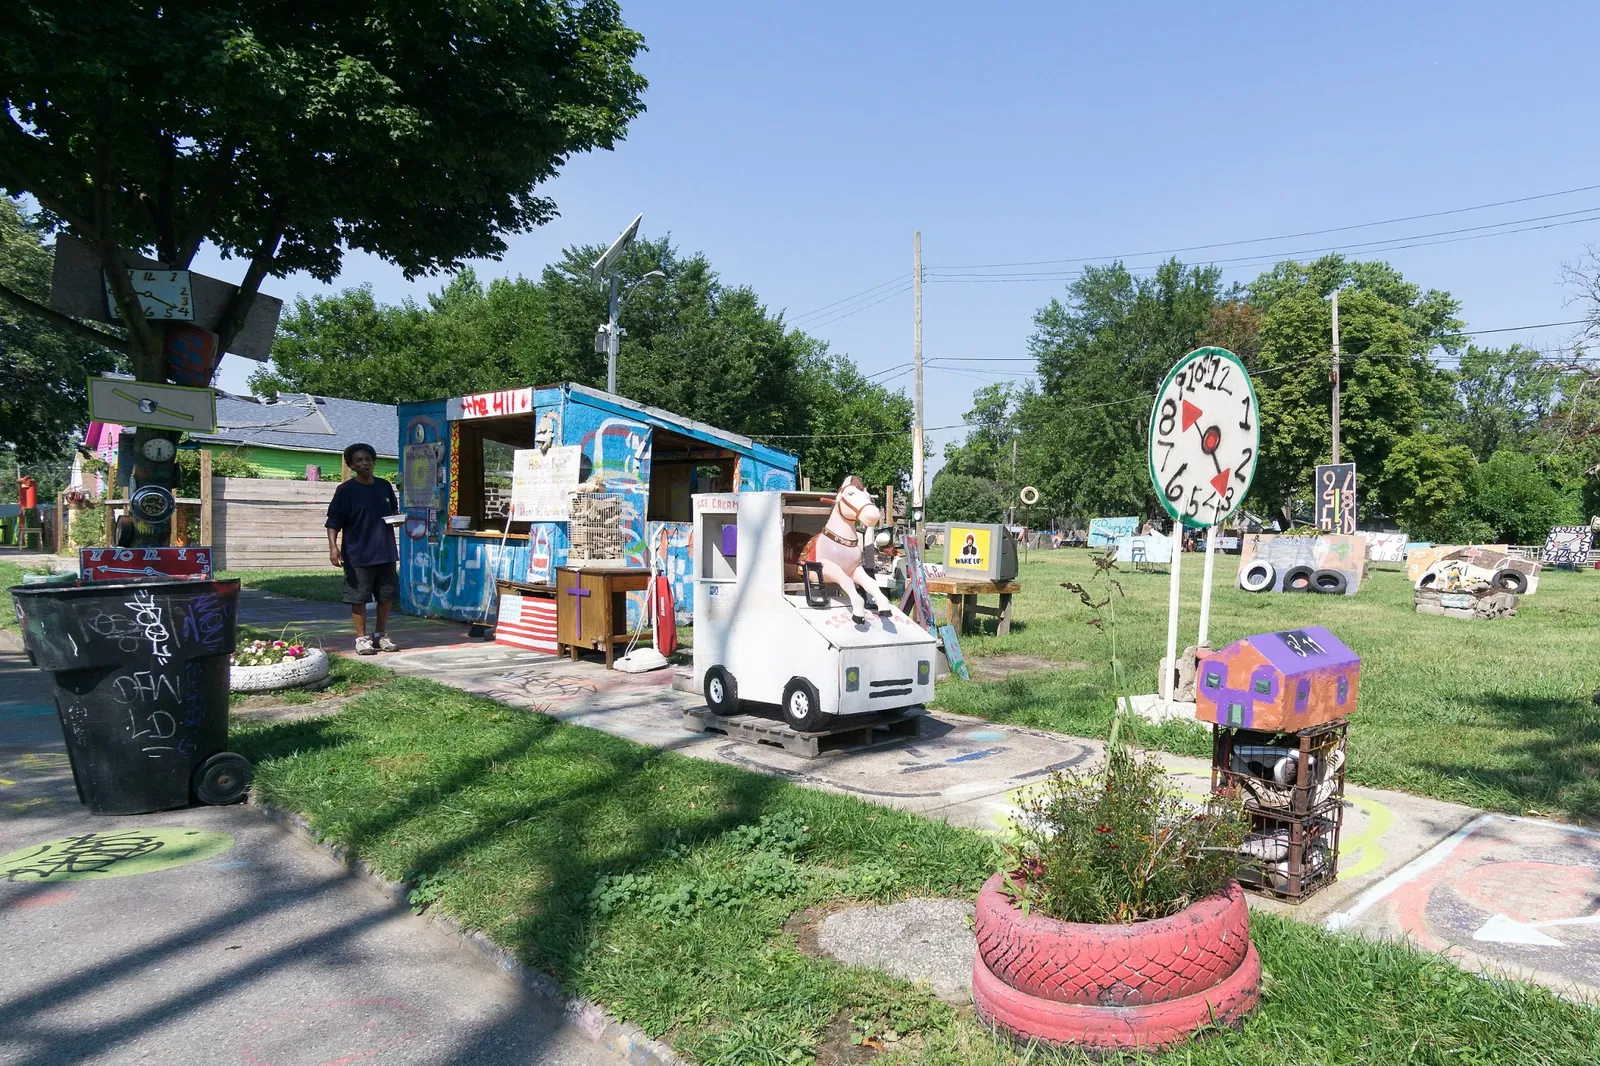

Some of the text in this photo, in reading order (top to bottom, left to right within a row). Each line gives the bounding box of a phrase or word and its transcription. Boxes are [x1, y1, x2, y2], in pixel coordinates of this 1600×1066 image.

[180, 287, 189, 296] 2
[181, 297, 189, 306] 3
[143, 307, 155, 317] 6
[164, 308, 173, 318] 5
[178, 307, 189, 317] 4
[1186, 361, 1204, 393] 10
[1204, 357, 1232, 396] 12
[1158, 396, 1251, 436] 8 1
[1157, 440, 1252, 483] 7 2
[1165, 463, 1188, 501] 6
[1185, 486, 1202, 518] 5
[696, 498, 739, 511] ICE CREAM
[113, 550, 133, 561] 10
[143, 549, 161, 560] 12
[178, 549, 187, 560] 1
[196, 552, 209, 564] 2
[954, 557, 972, 565] WAKE
